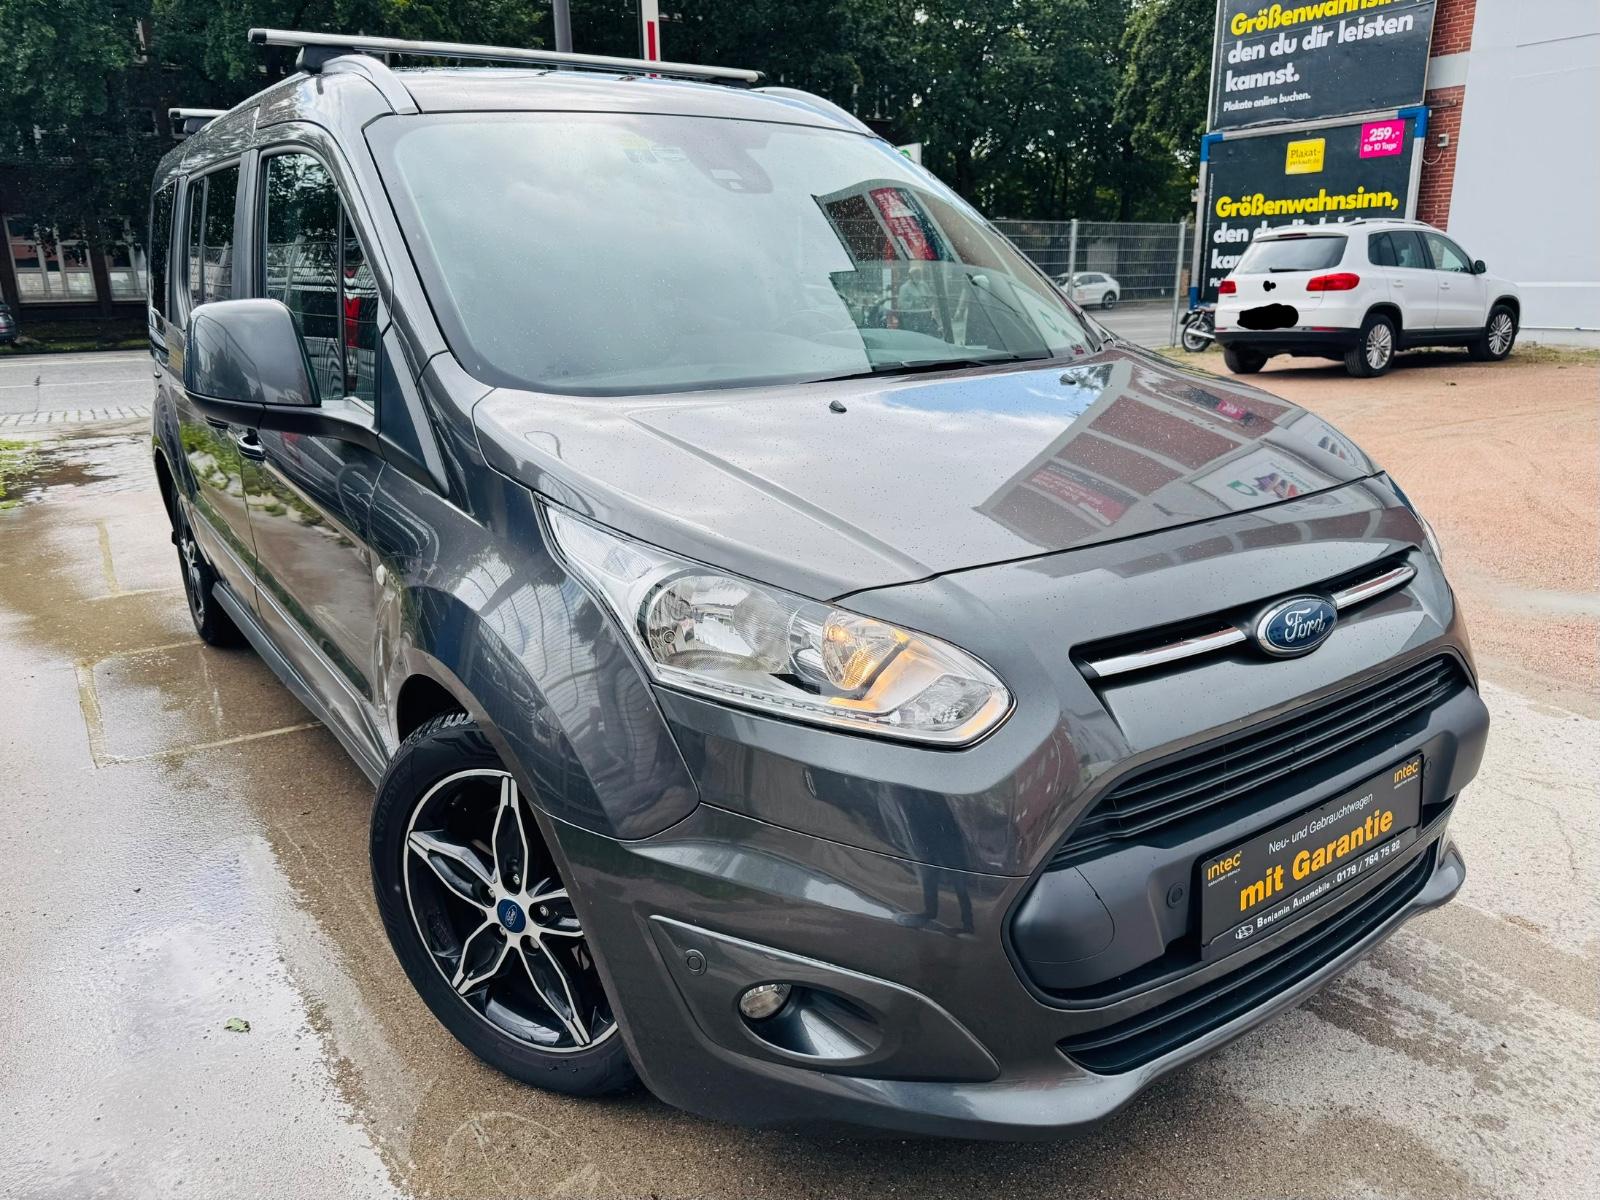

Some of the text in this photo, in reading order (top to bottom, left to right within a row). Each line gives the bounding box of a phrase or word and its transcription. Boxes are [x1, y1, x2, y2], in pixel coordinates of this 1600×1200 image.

[1227, 14, 1413, 64] den du dir leisten
[1225, 63, 1300, 92] kannst.
[1223, 90, 1311, 112] Plakate online buchen.
[1215, 186, 1399, 218] Größenwahnsinn,
[1213, 222, 1249, 245] den
[1285, 608, 1325, 642] Ford
[1268, 793, 1373, 854] Neu- und Gebrauchtwagen
[1240, 809, 1393, 911] mit Garantie
[1257, 905, 1290, 928] Benjamin
[1293, 882, 1330, 908] Automobile
